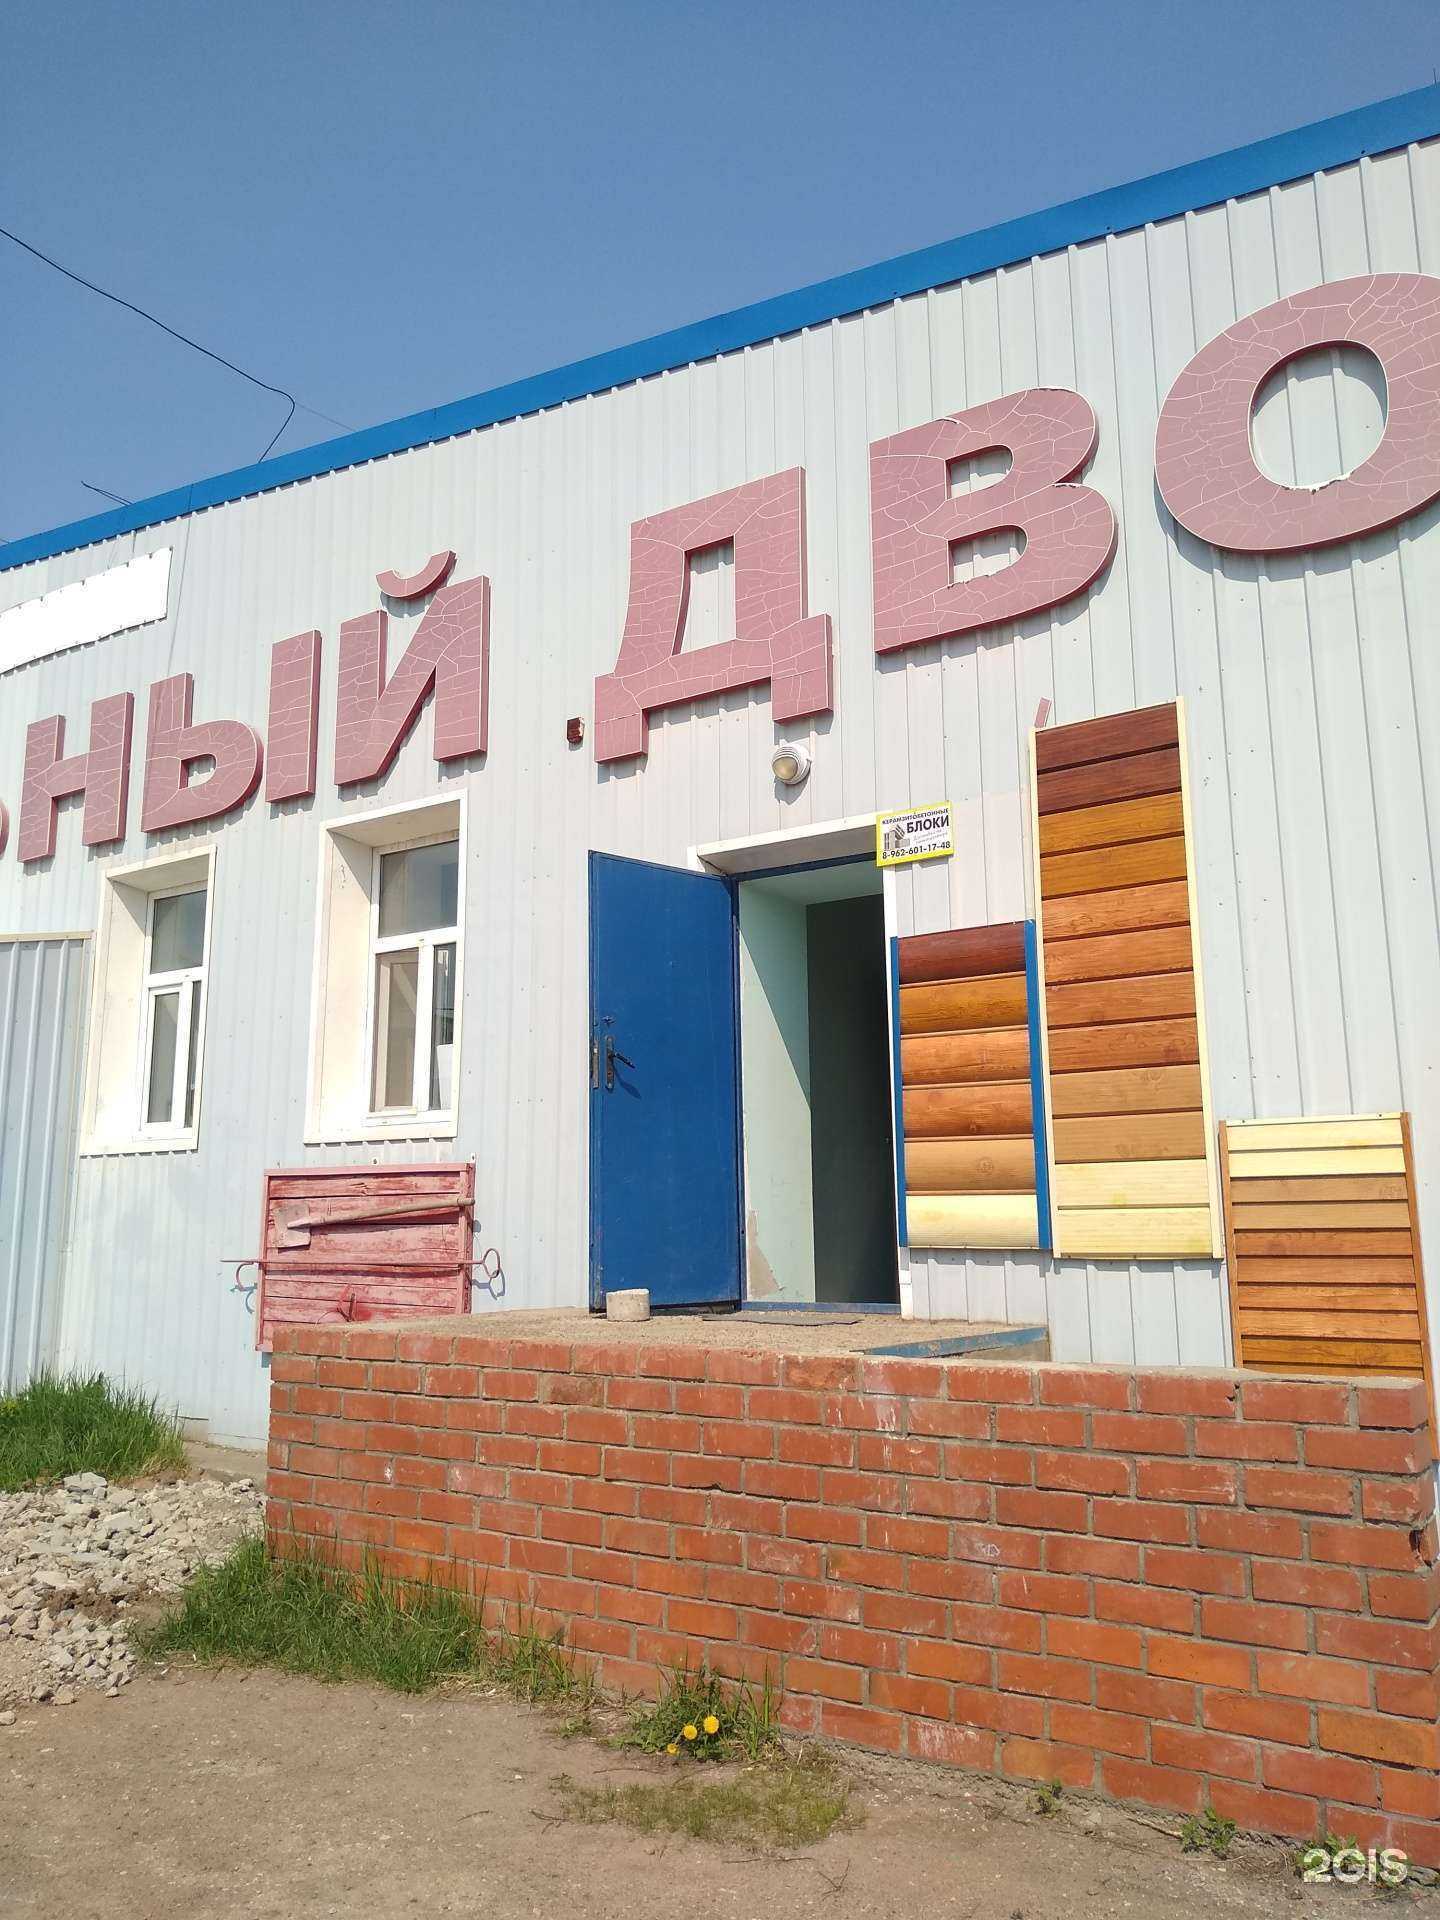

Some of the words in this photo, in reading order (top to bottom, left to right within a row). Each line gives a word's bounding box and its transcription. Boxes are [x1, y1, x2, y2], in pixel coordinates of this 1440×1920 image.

[0, 550, 491, 863] НЫЙ
[595, 272, 1440, 762] ДВО
[906, 815, 950, 834] БЛОКИ
[882, 841, 951, 860] 8-962-601-17-48
